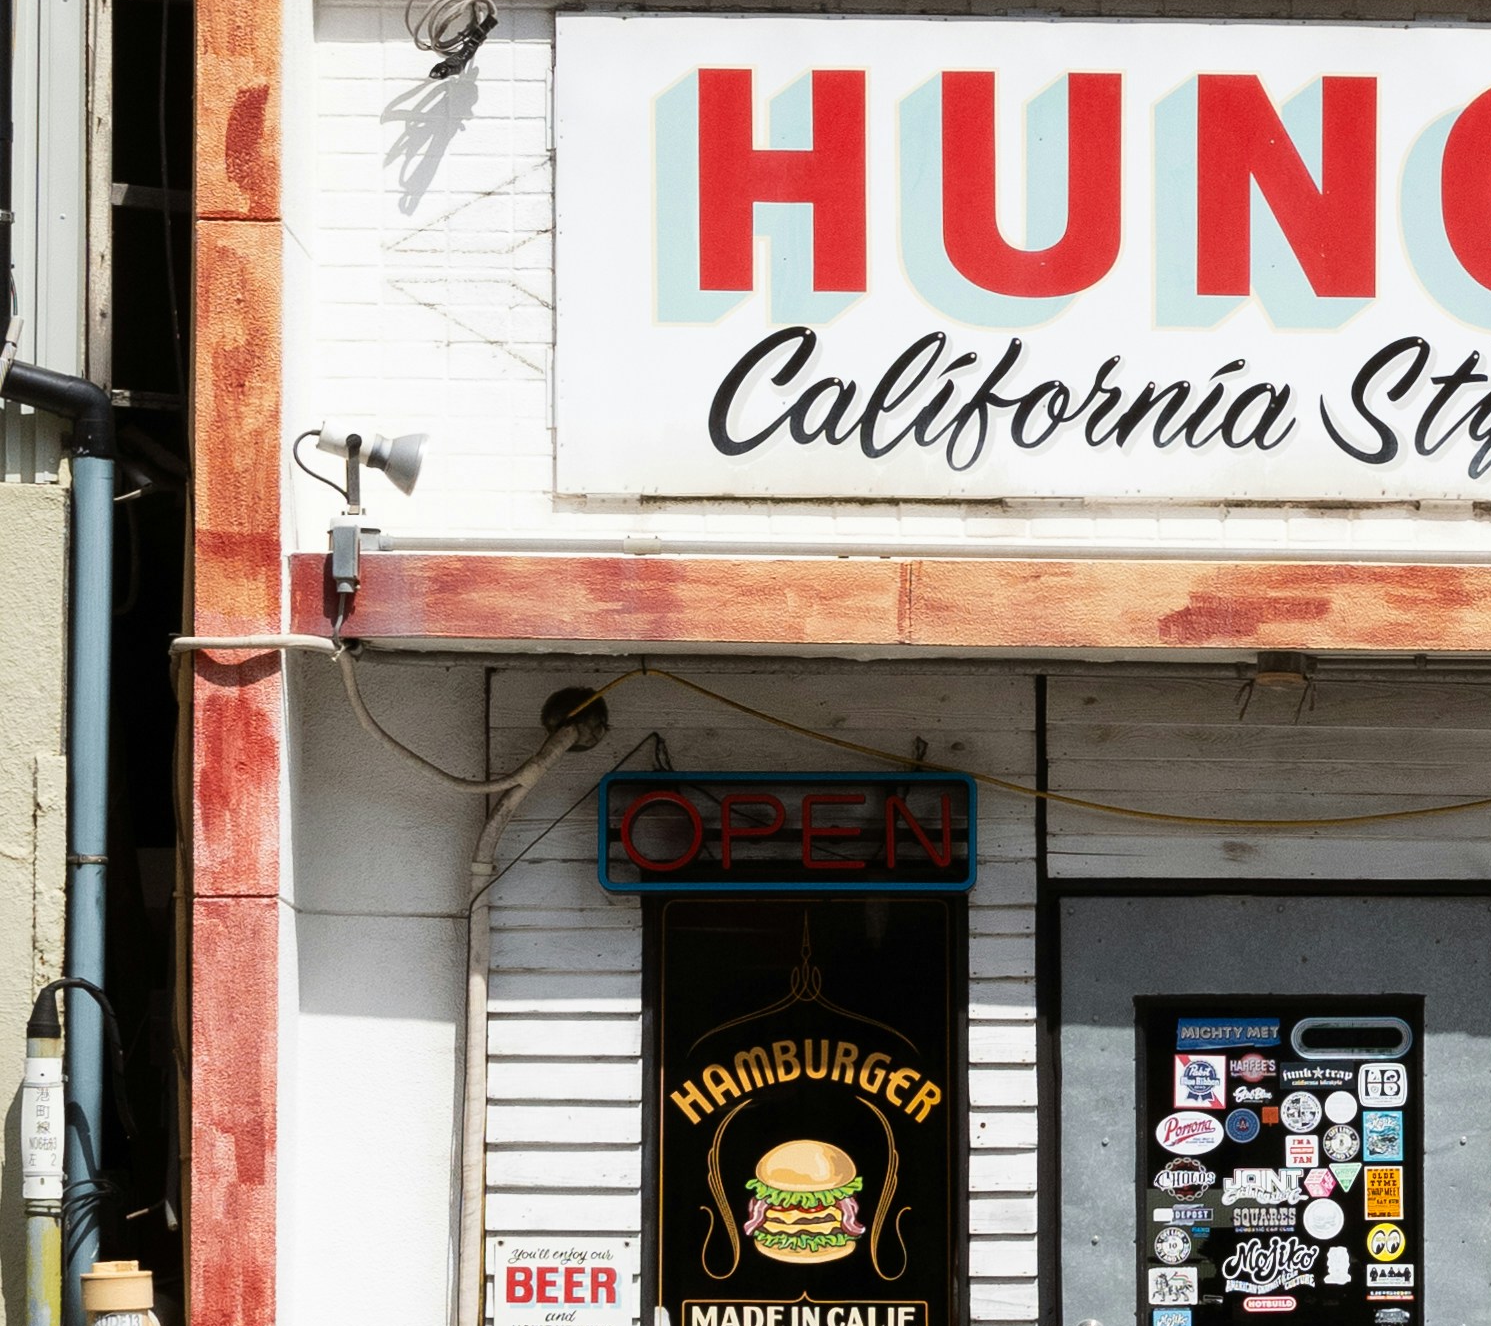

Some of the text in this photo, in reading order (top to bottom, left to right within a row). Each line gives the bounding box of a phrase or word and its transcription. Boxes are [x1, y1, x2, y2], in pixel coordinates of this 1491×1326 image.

[707, 325, 1297, 472] California
[619, 789, 951, 871] OPEN
[1180, 1025, 1243, 1040] MIGHTY
[669, 1038, 944, 1124] HAMBURGER
[1324, 1068, 1354, 1082] trap
[1163, 1116, 1217, 1145] Pomona
[1293, 1156, 1313, 1164] FAN
[1233, 1207, 1297, 1227] SQUARES
[507, 1247, 614, 1265] You'll enjoy our
[1222, 1236, 1320, 1285] Mojiko
[505, 1266, 618, 1305] BEER
[544, 1309, 578, 1322] and
